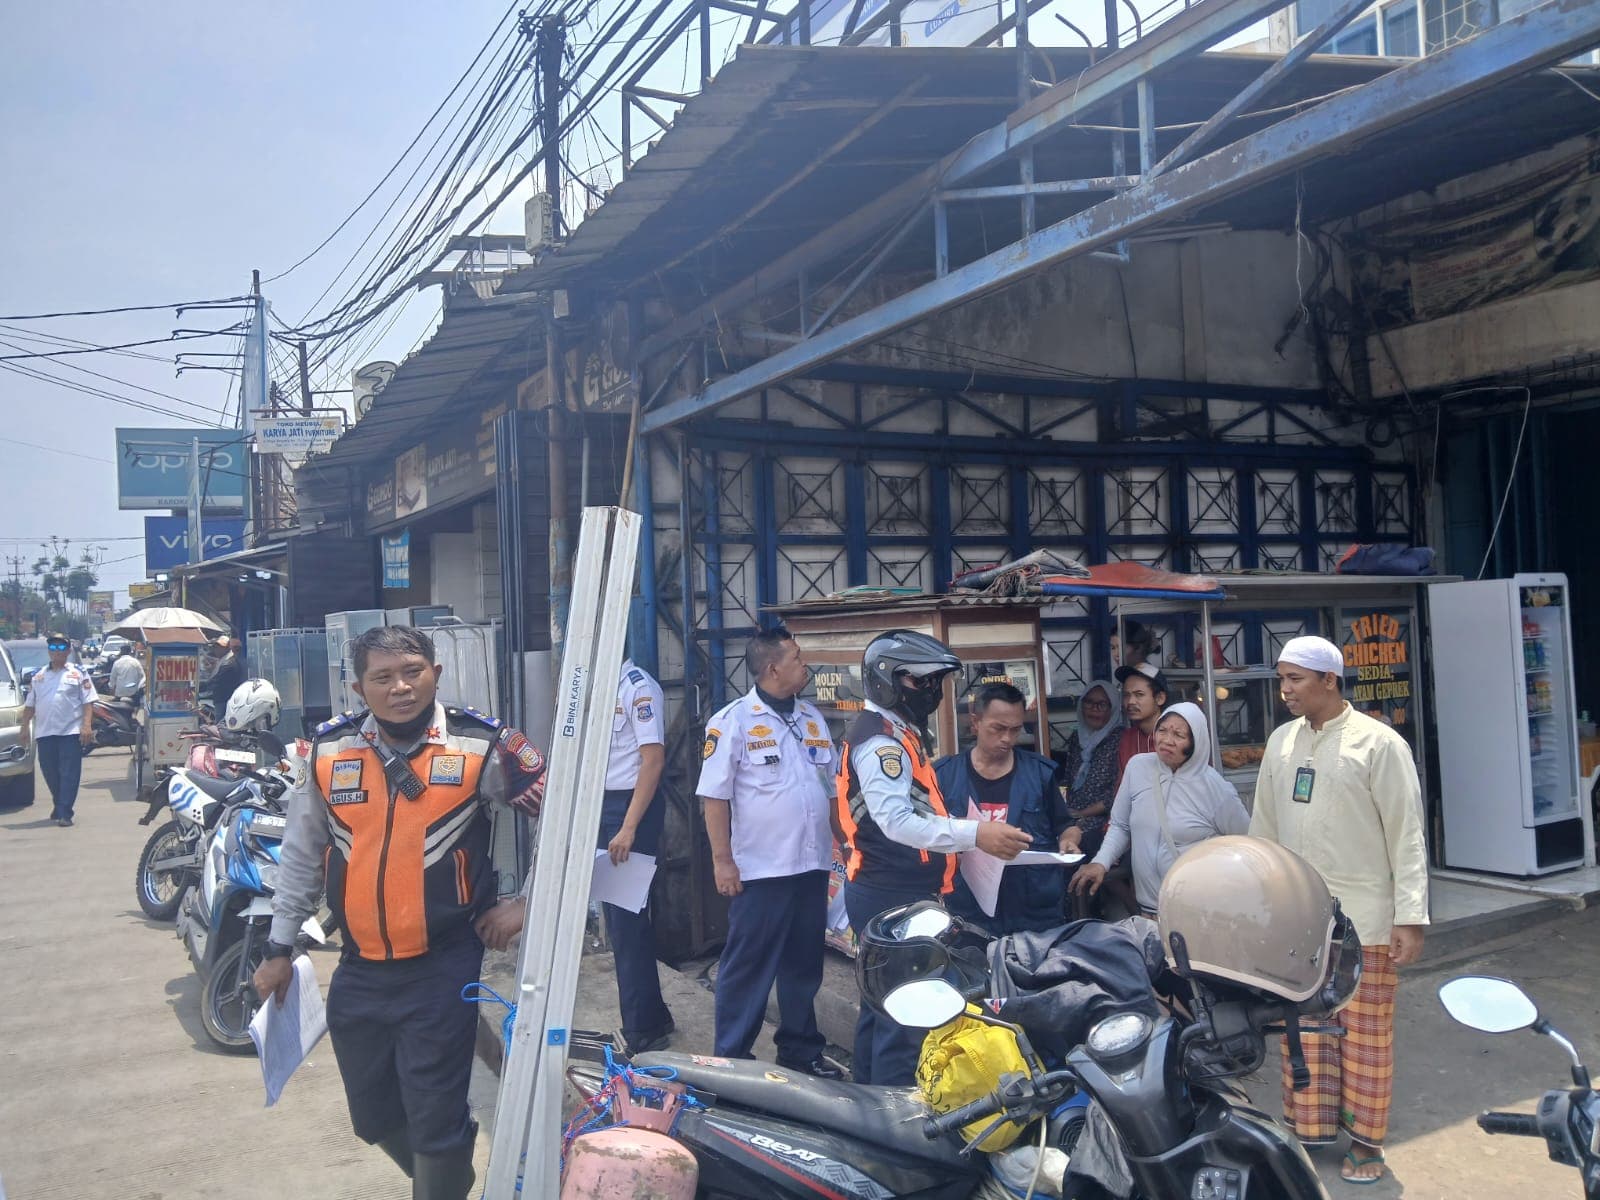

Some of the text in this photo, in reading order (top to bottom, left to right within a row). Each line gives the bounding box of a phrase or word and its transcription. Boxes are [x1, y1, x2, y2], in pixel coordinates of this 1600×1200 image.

[263, 429, 287, 437] KARYA
[289, 429, 304, 437] JATI
[1351, 612, 1399, 641] FRIED
[1343, 641, 1406, 667] CHICKEN
[156, 660, 197, 681] SOMAY
[814, 672, 842, 687] MOLEN
[816, 688, 835, 701] MINI
[1353, 681, 1410, 702] AYAM GEPREK
[331, 792, 362, 803] AGUS.H
